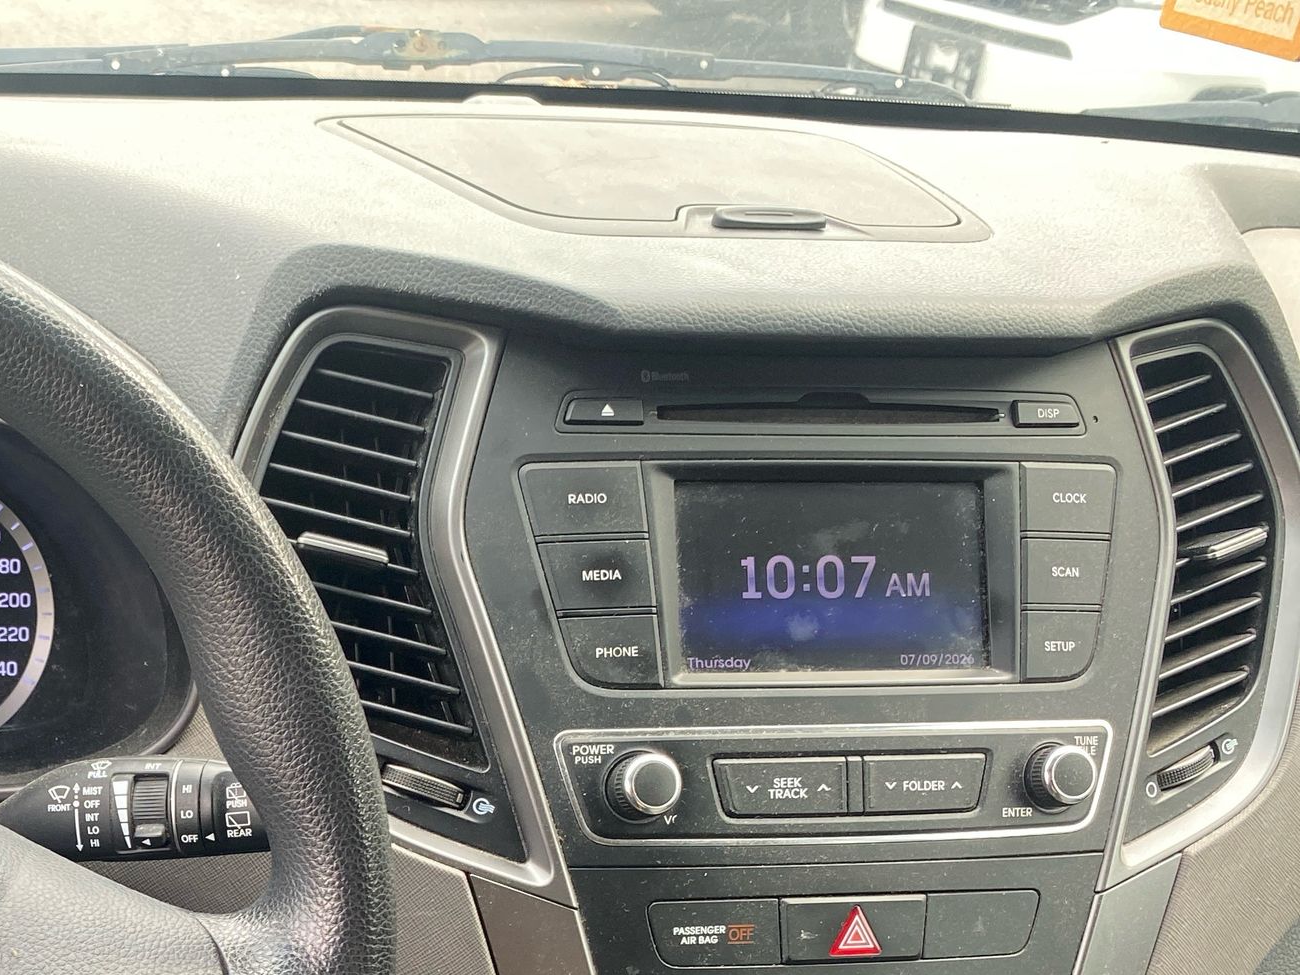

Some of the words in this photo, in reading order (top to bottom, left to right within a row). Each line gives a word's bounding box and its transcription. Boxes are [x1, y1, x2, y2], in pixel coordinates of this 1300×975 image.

[1244, 0, 1294, 25] Peach
[1037, 408, 1060, 419] DISP
[568, 493, 607, 504] RADIO
[1052, 493, 1087, 504] CLOCK
[582, 569, 622, 581] MEDIA
[740, 555, 876, 599] 10:07
[885, 572, 931, 597] AM
[1051, 567, 1079, 578] SCAN
[1044, 641, 1075, 652] SETUP
[595, 646, 639, 658] PHONE
[687, 657, 751, 670] Thursday
[900, 653, 975, 666] 07/09/2026
[1074, 735, 1099, 746] TUNE
[572, 744, 614, 756] POWER
[574, 755, 601, 764] PUSH
[88, 770, 108, 779] PULL
[773, 778, 802, 788] SEEK
[903, 781, 945, 791] FOLDER
[82, 786, 103, 796] MIST
[182, 784, 193, 794] HI
[768, 788, 808, 799] TRACK
[47, 804, 71, 812] FRONT
[83, 800, 100, 809] OFF
[226, 799, 247, 808] PUSH
[85, 813, 100, 822] INT
[180, 810, 194, 819] LO
[1002, 808, 1033, 818] ENTER
[87, 826, 100, 835] LO
[227, 829, 252, 838] REAR
[90, 839, 100, 848] HI
[181, 834, 199, 844] OFF
[673, 925, 726, 936] PASSENGER
[728, 928, 754, 940] OFF
[680, 935, 697, 945] AIR
[698, 935, 718, 945] BAG
